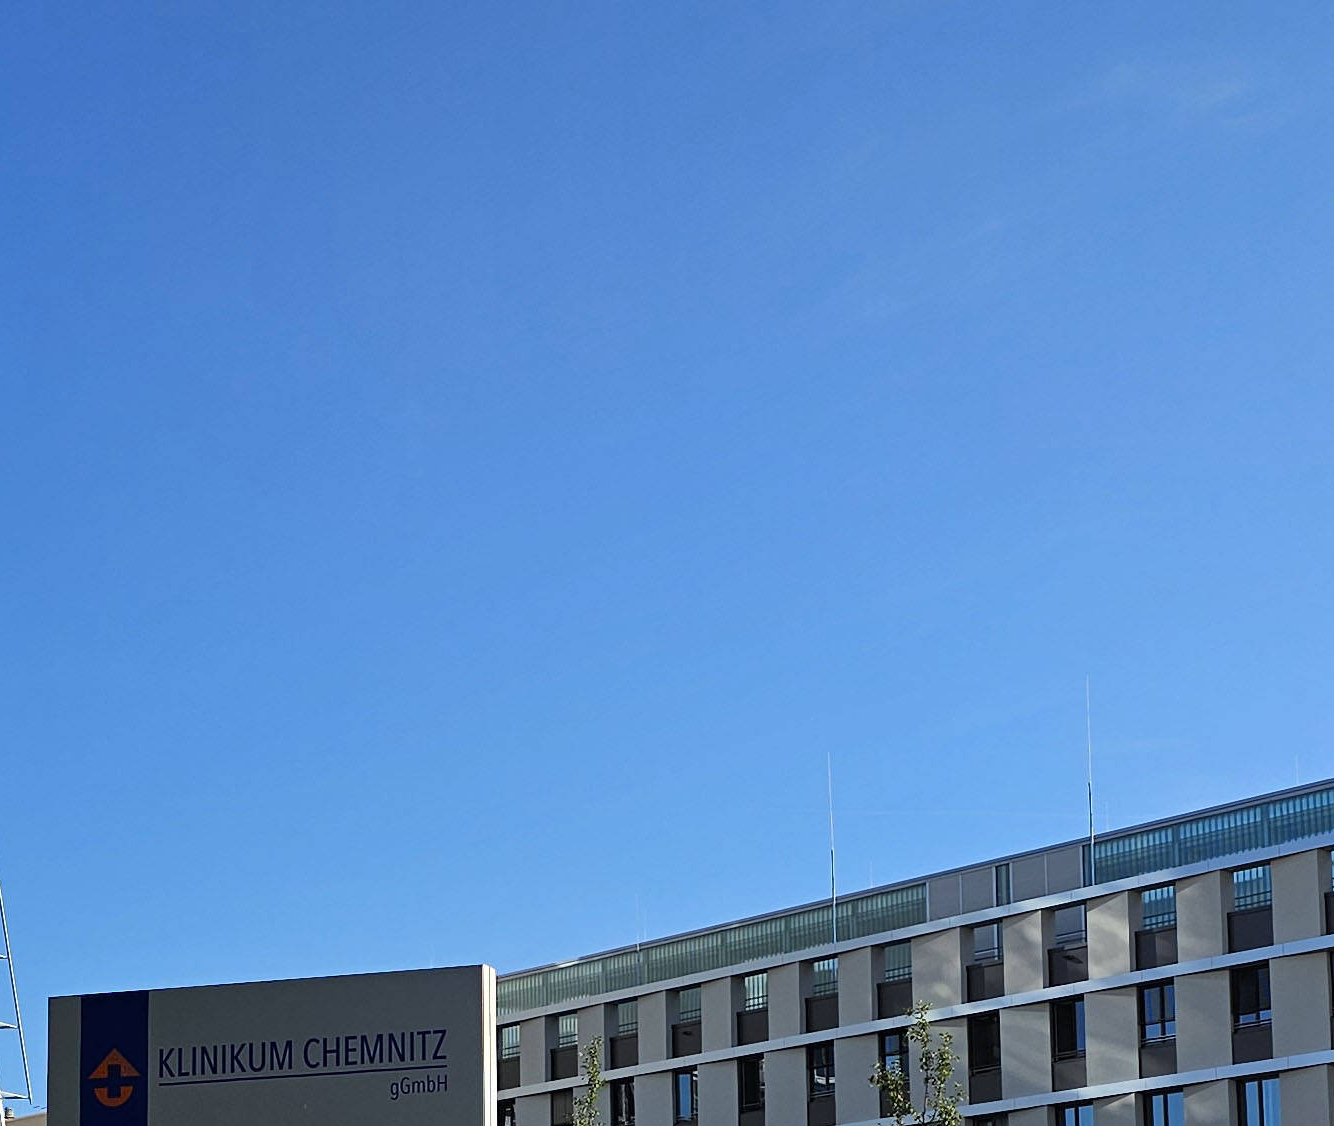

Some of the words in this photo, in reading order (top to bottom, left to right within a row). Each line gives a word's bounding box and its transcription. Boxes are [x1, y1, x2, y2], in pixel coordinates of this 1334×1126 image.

[158, 1040, 293, 1079] KLINIKUM
[303, 1030, 448, 1069] CHEMNITZ
[390, 1074, 448, 1101] gGmbH
